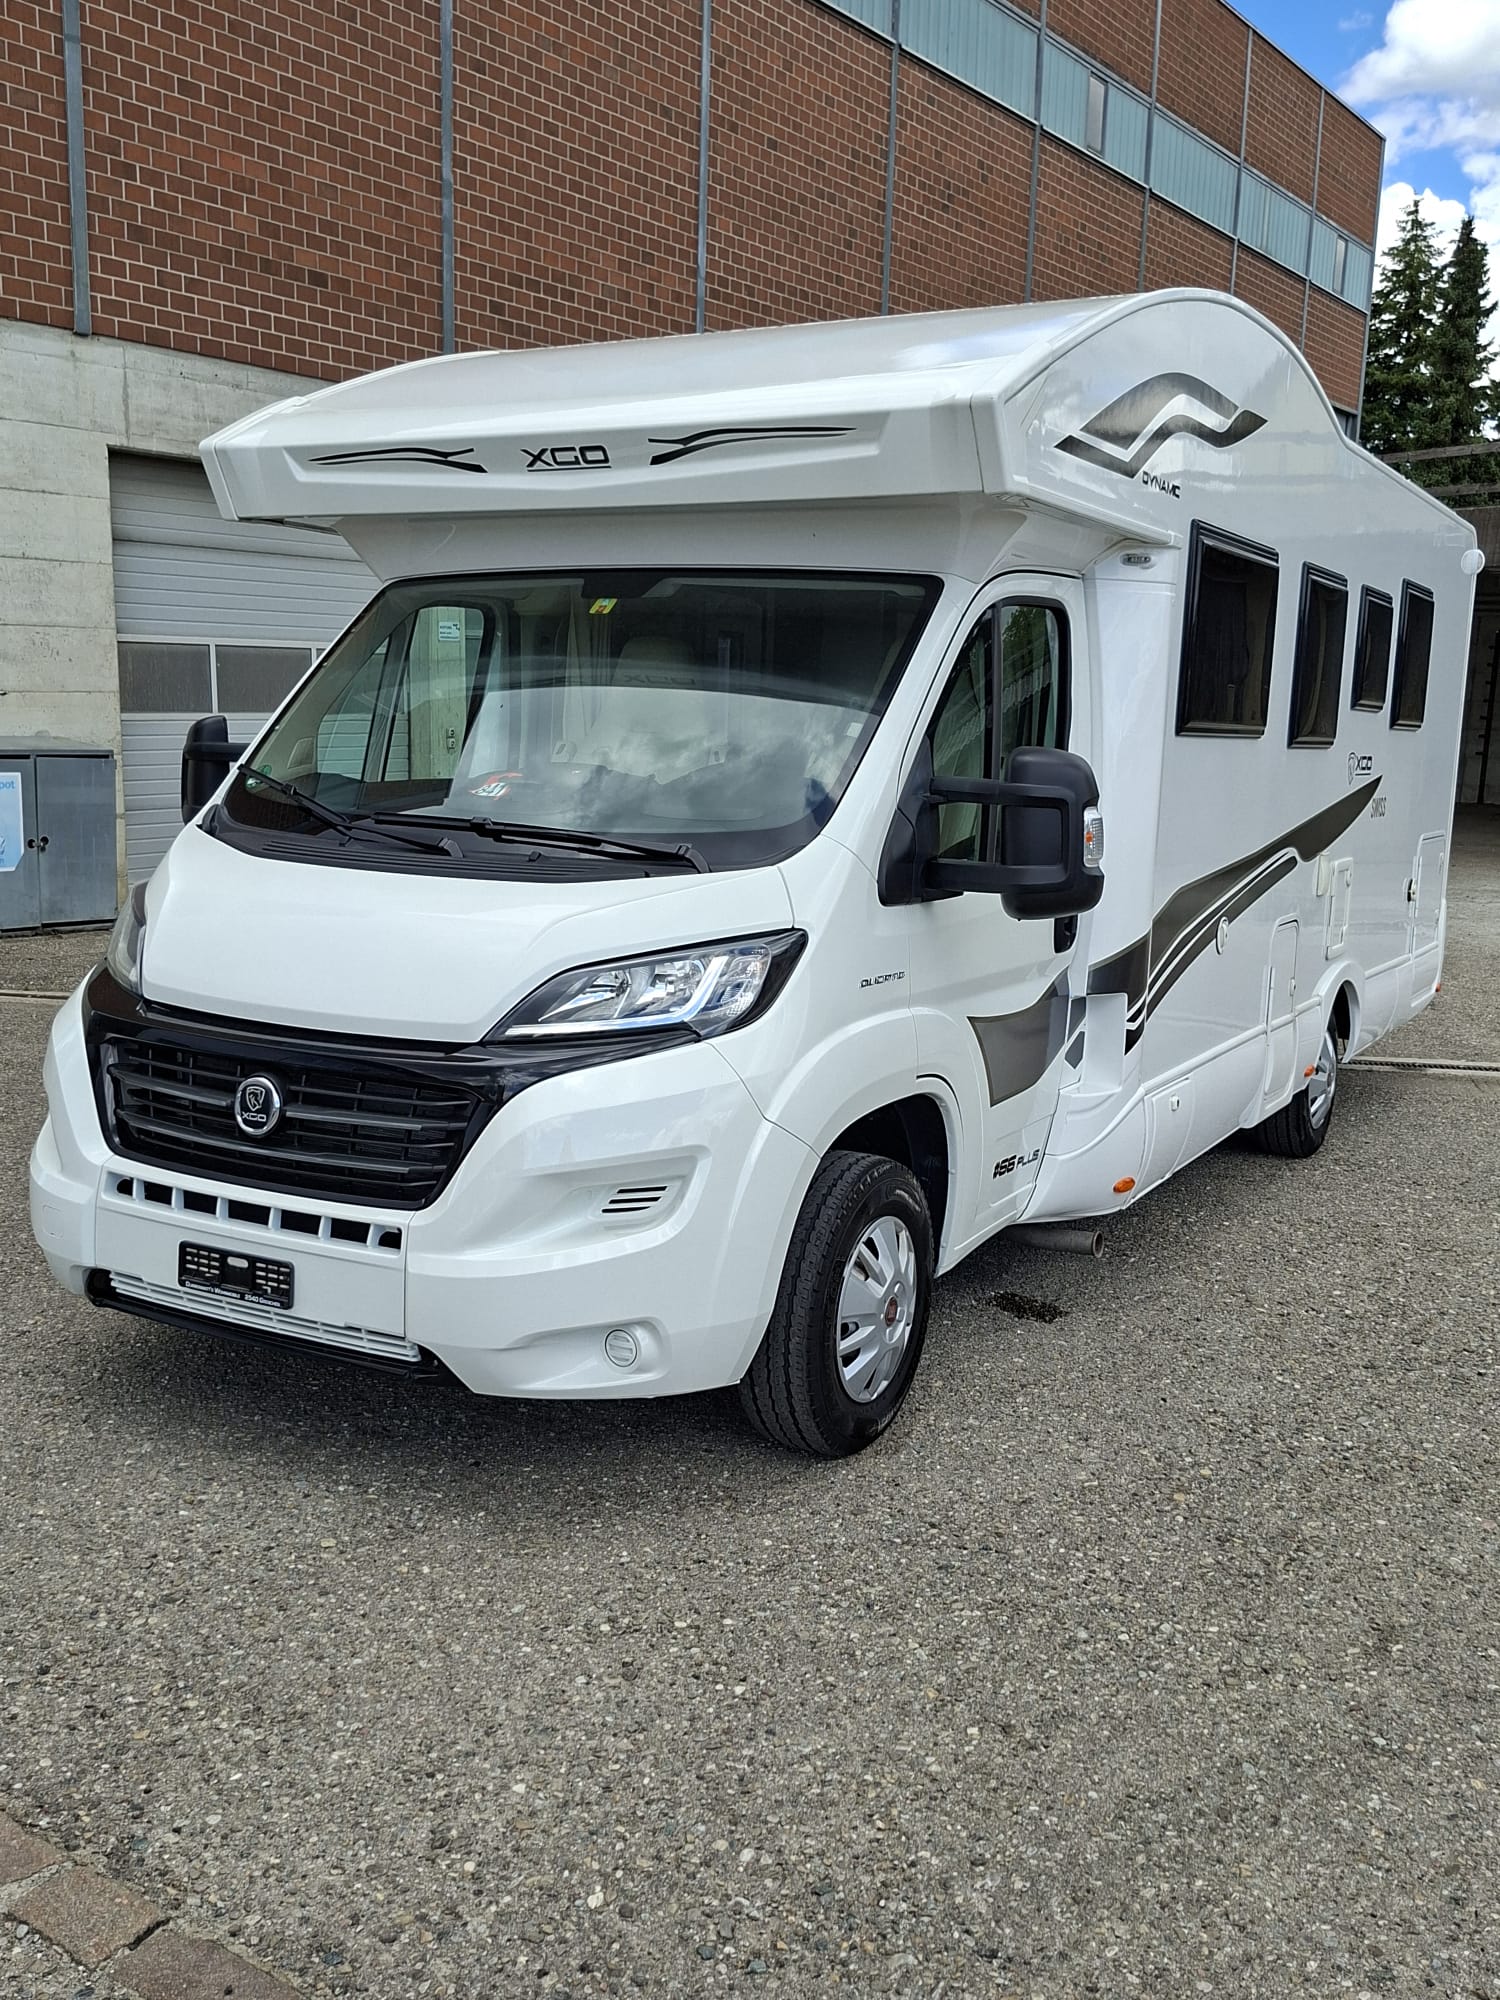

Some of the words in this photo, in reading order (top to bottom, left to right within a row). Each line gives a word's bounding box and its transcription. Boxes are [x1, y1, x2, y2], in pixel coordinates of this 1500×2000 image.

[520, 445, 611, 468] XGO
[860, 971, 906, 988] DUCATO
[1016, 1149, 1040, 1169] PLUS
